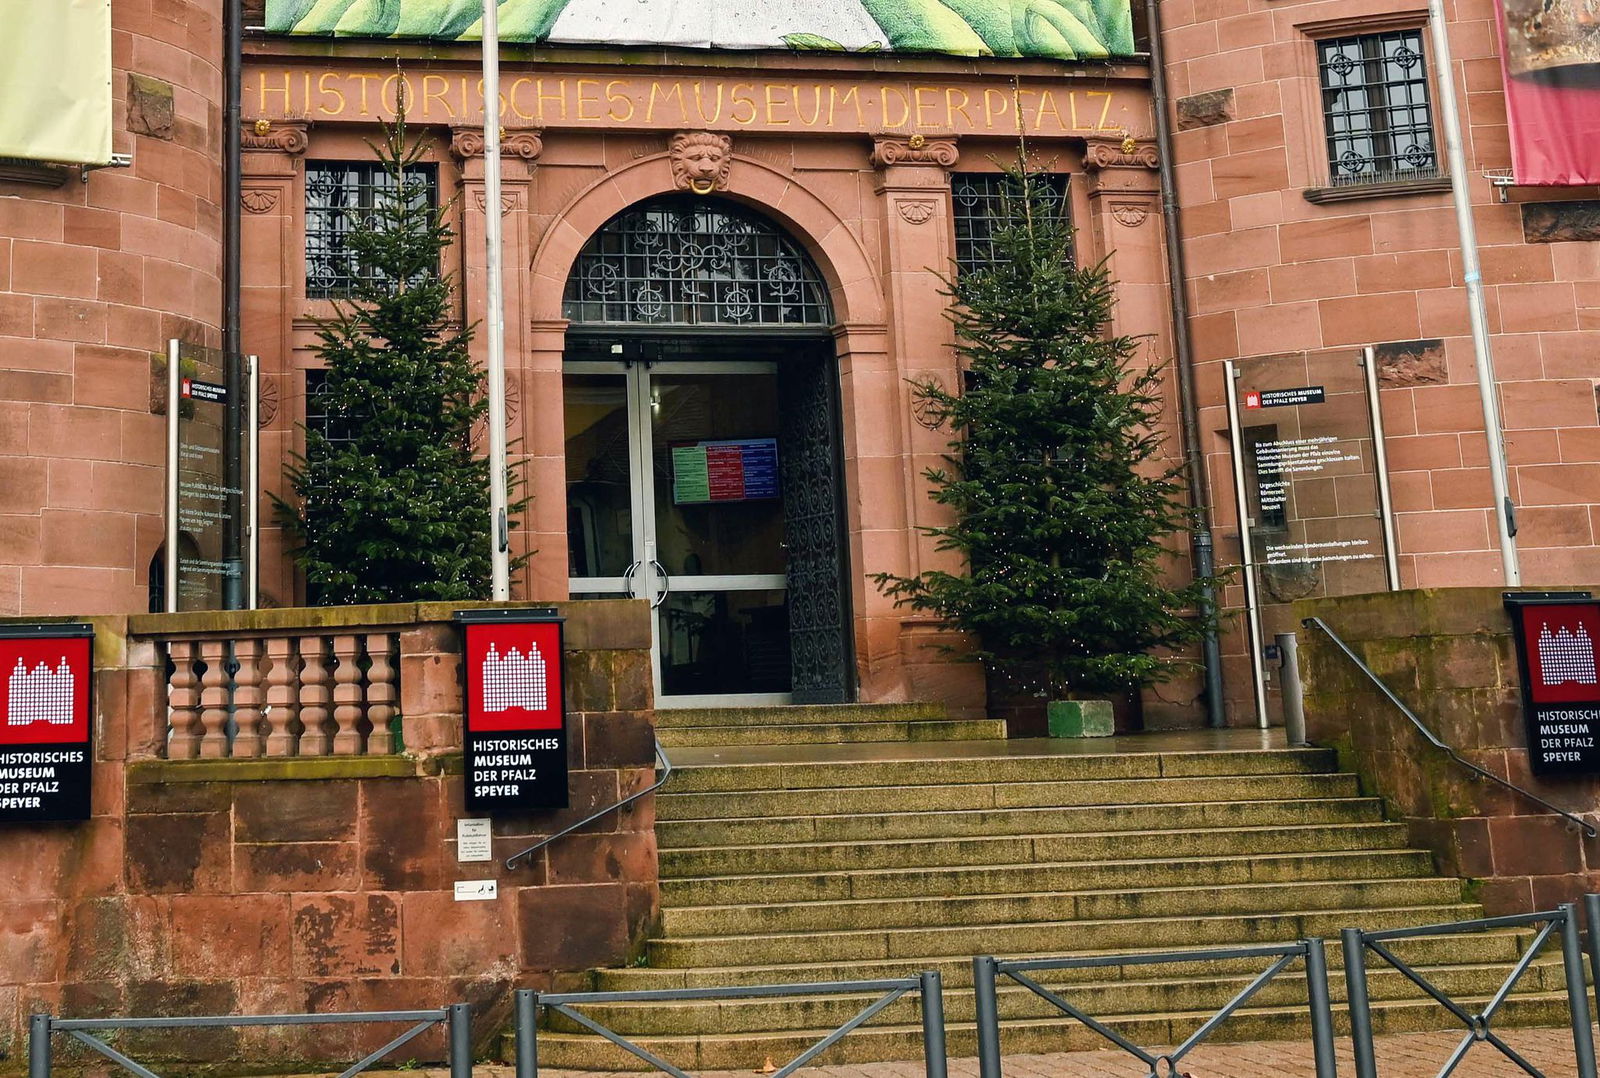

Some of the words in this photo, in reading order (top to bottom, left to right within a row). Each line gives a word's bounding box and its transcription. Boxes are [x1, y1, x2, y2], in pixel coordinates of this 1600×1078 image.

[644, 80, 867, 128] MUSEUM
[879, 86, 977, 130] DER
[984, 88, 1128, 133] PFALZ
[1262, 391, 1297, 399] HISTORISCHES
[1538, 710, 1600, 721] HISTORISCH
[1540, 724, 1589, 735] MUSEUM
[473, 738, 559, 752] HISTORISCHES
[1541, 738, 1561, 748] DER
[1564, 737, 1594, 748] PFALZ
[474, 754, 532, 766] MUSEUM
[1543, 752, 1581, 762] SPEYER
[0, 767, 55, 779] MUSEUM
[474, 770, 497, 782] DER
[501, 769, 536, 781] PFALZ
[23, 782, 59, 793] PFALZ
[474, 785, 519, 797] SPEYER
[0, 797, 40, 809] PEYER
